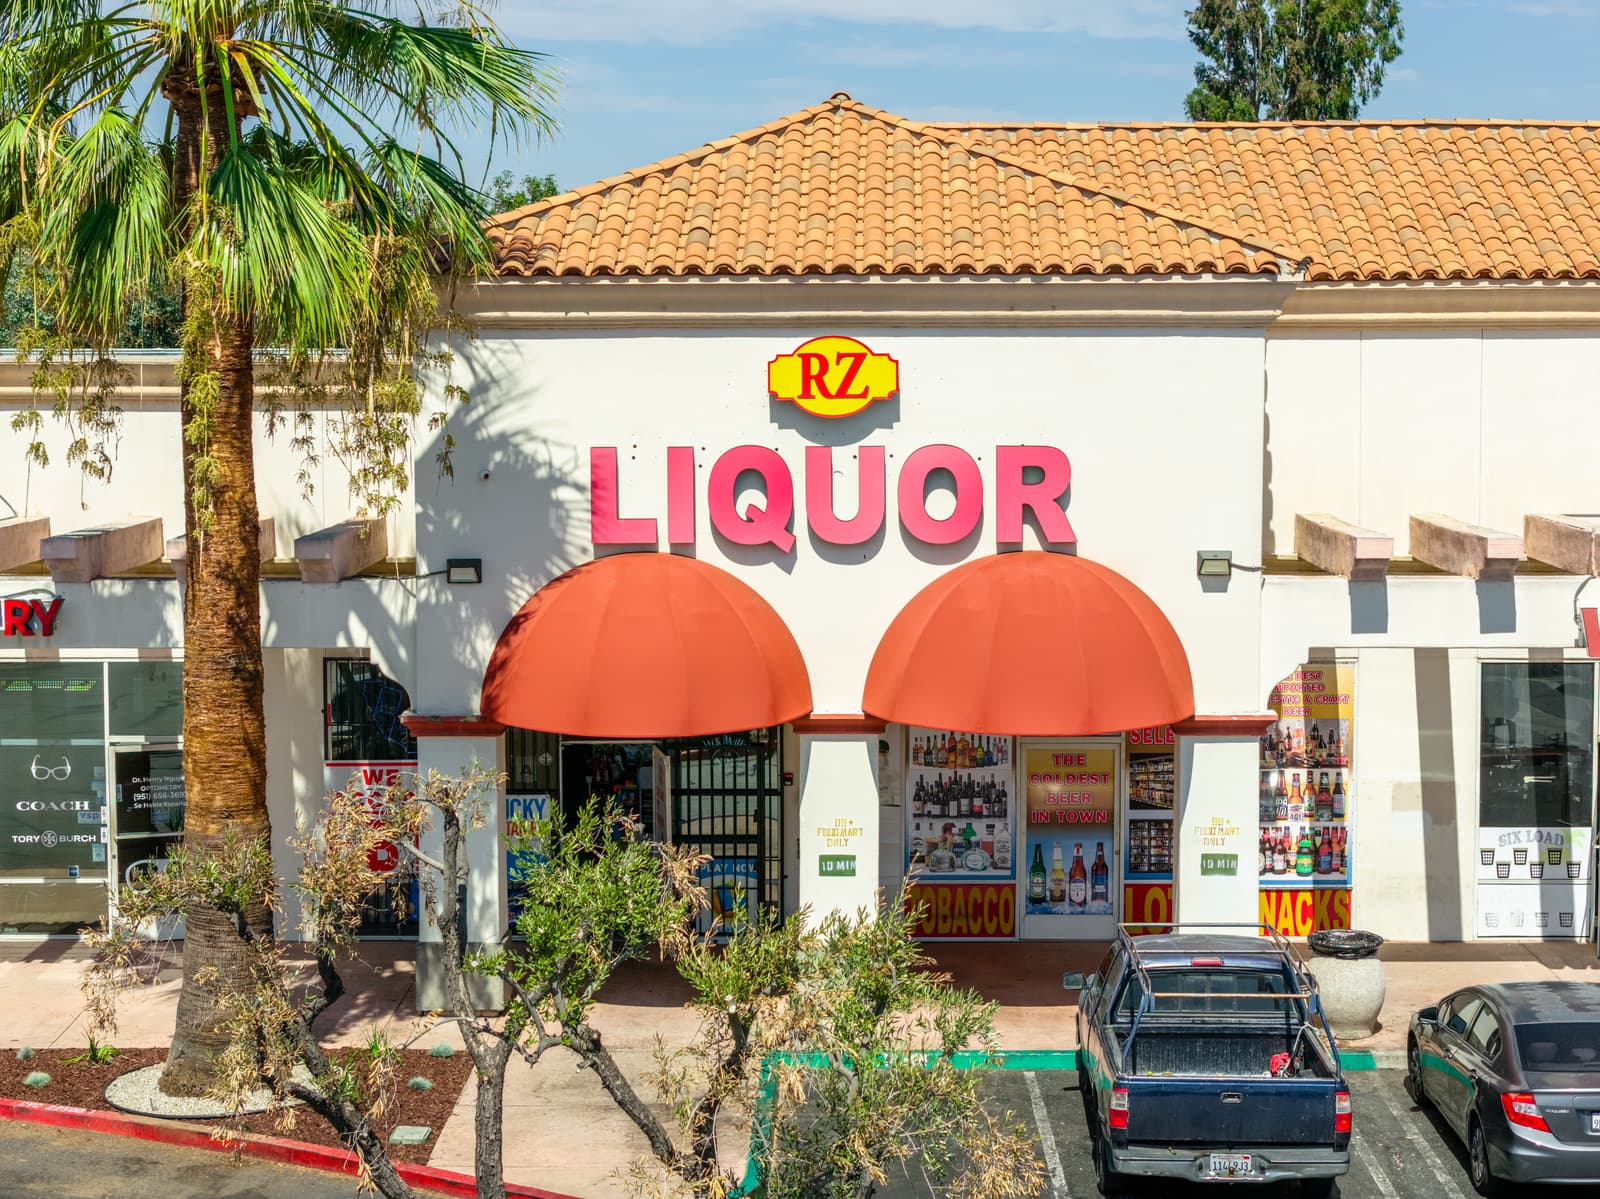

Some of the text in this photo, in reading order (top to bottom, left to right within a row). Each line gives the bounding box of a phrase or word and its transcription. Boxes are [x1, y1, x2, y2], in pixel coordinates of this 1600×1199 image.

[799, 352, 870, 400] RZ
[590, 444, 1078, 554] LIQUOR
[1295, 671, 1323, 680] BEST
[1315, 695, 1349, 704] CRAFT
[1283, 707, 1311, 716] BEER
[1053, 753, 1086, 767] THE
[362, 769, 399, 786] WE
[1030, 773, 1110, 785] COLDEST
[1046, 792, 1092, 804] BEER
[16, 801, 90, 811] COACH
[1031, 810, 1107, 823] IN TOWN
[12, 834, 96, 843] TORY BURCH
[1498, 830, 1564, 847] SIX LOAD
